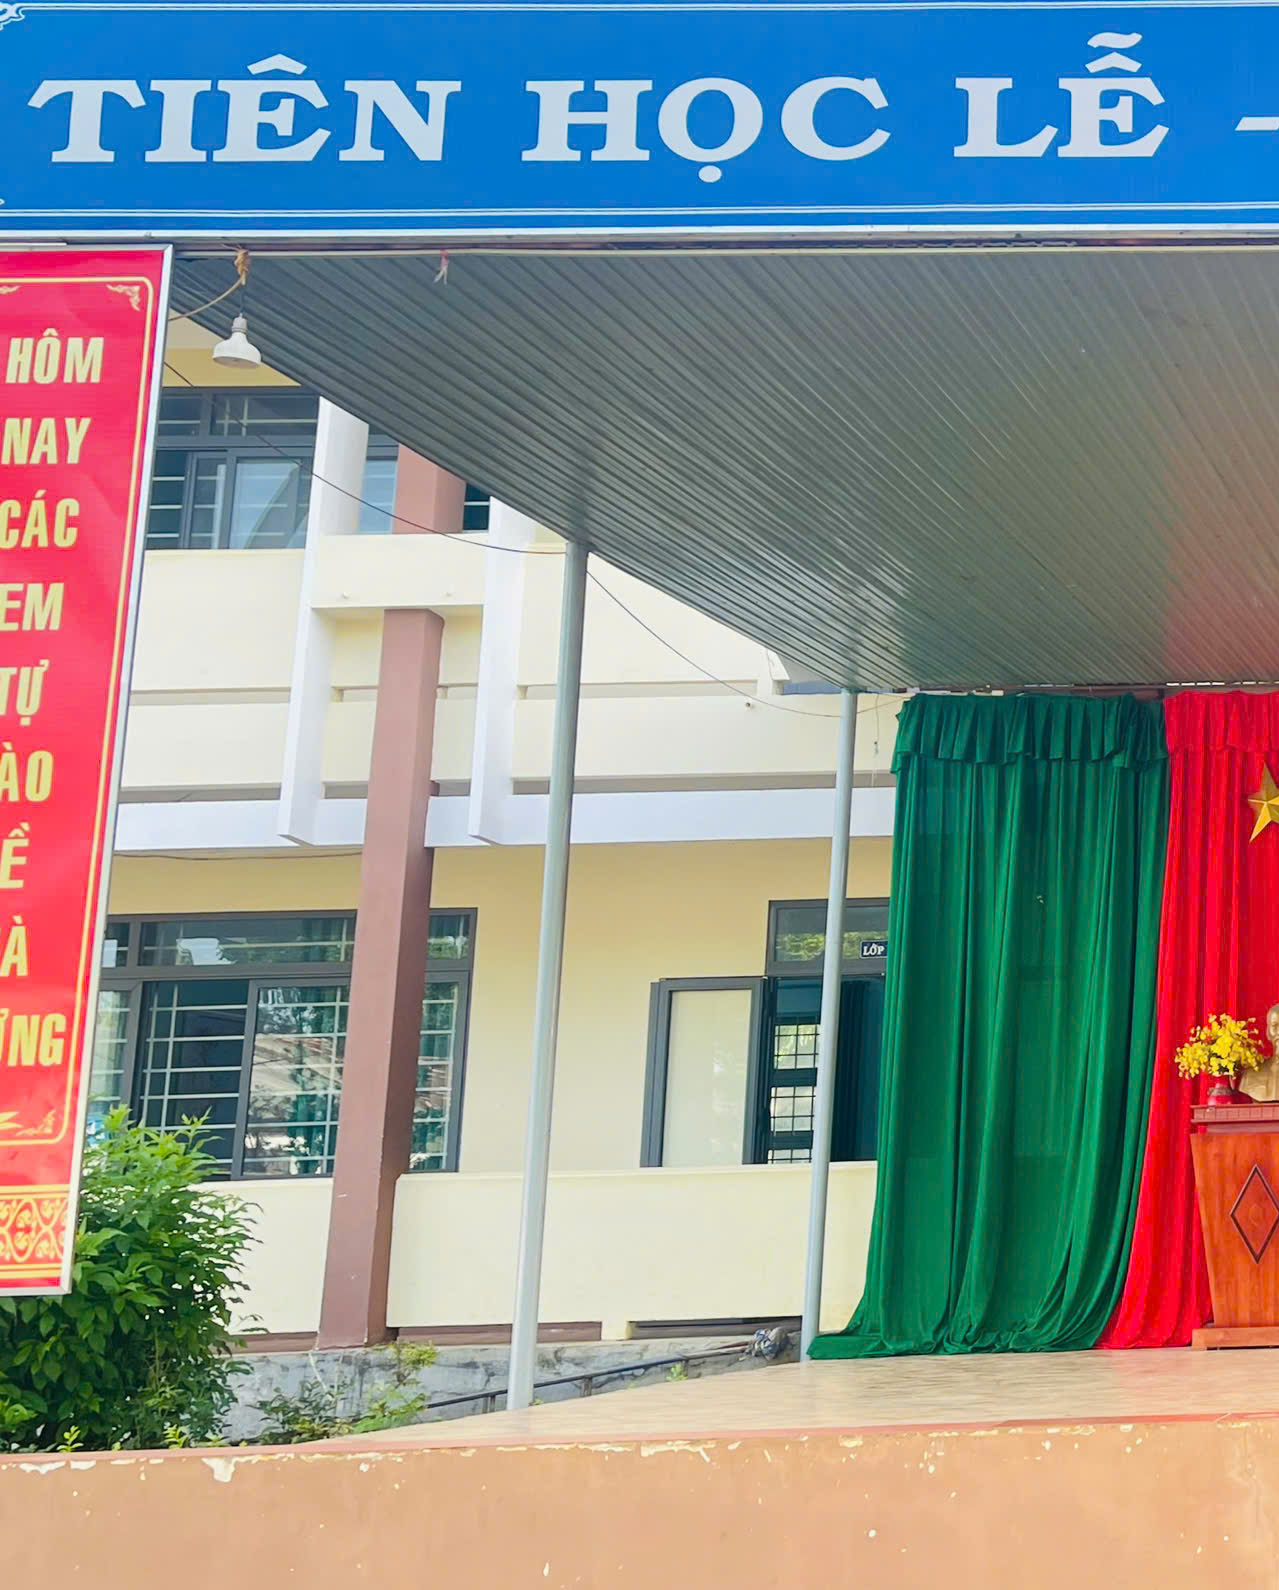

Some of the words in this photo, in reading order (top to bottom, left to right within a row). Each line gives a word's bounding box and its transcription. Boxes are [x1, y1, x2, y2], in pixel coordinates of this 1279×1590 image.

[27, 53, 462, 163] TIÊN
[522, 76, 892, 183] HỌC
[953, 31, 1170, 158] LỄ
[6, 328, 104, 384] HÔM
[1, 417, 91, 465] NAY
[0, 489, 80, 549] CÁC
[0, 582, 65, 631] EM
[0, 741, 54, 802] ÀO
